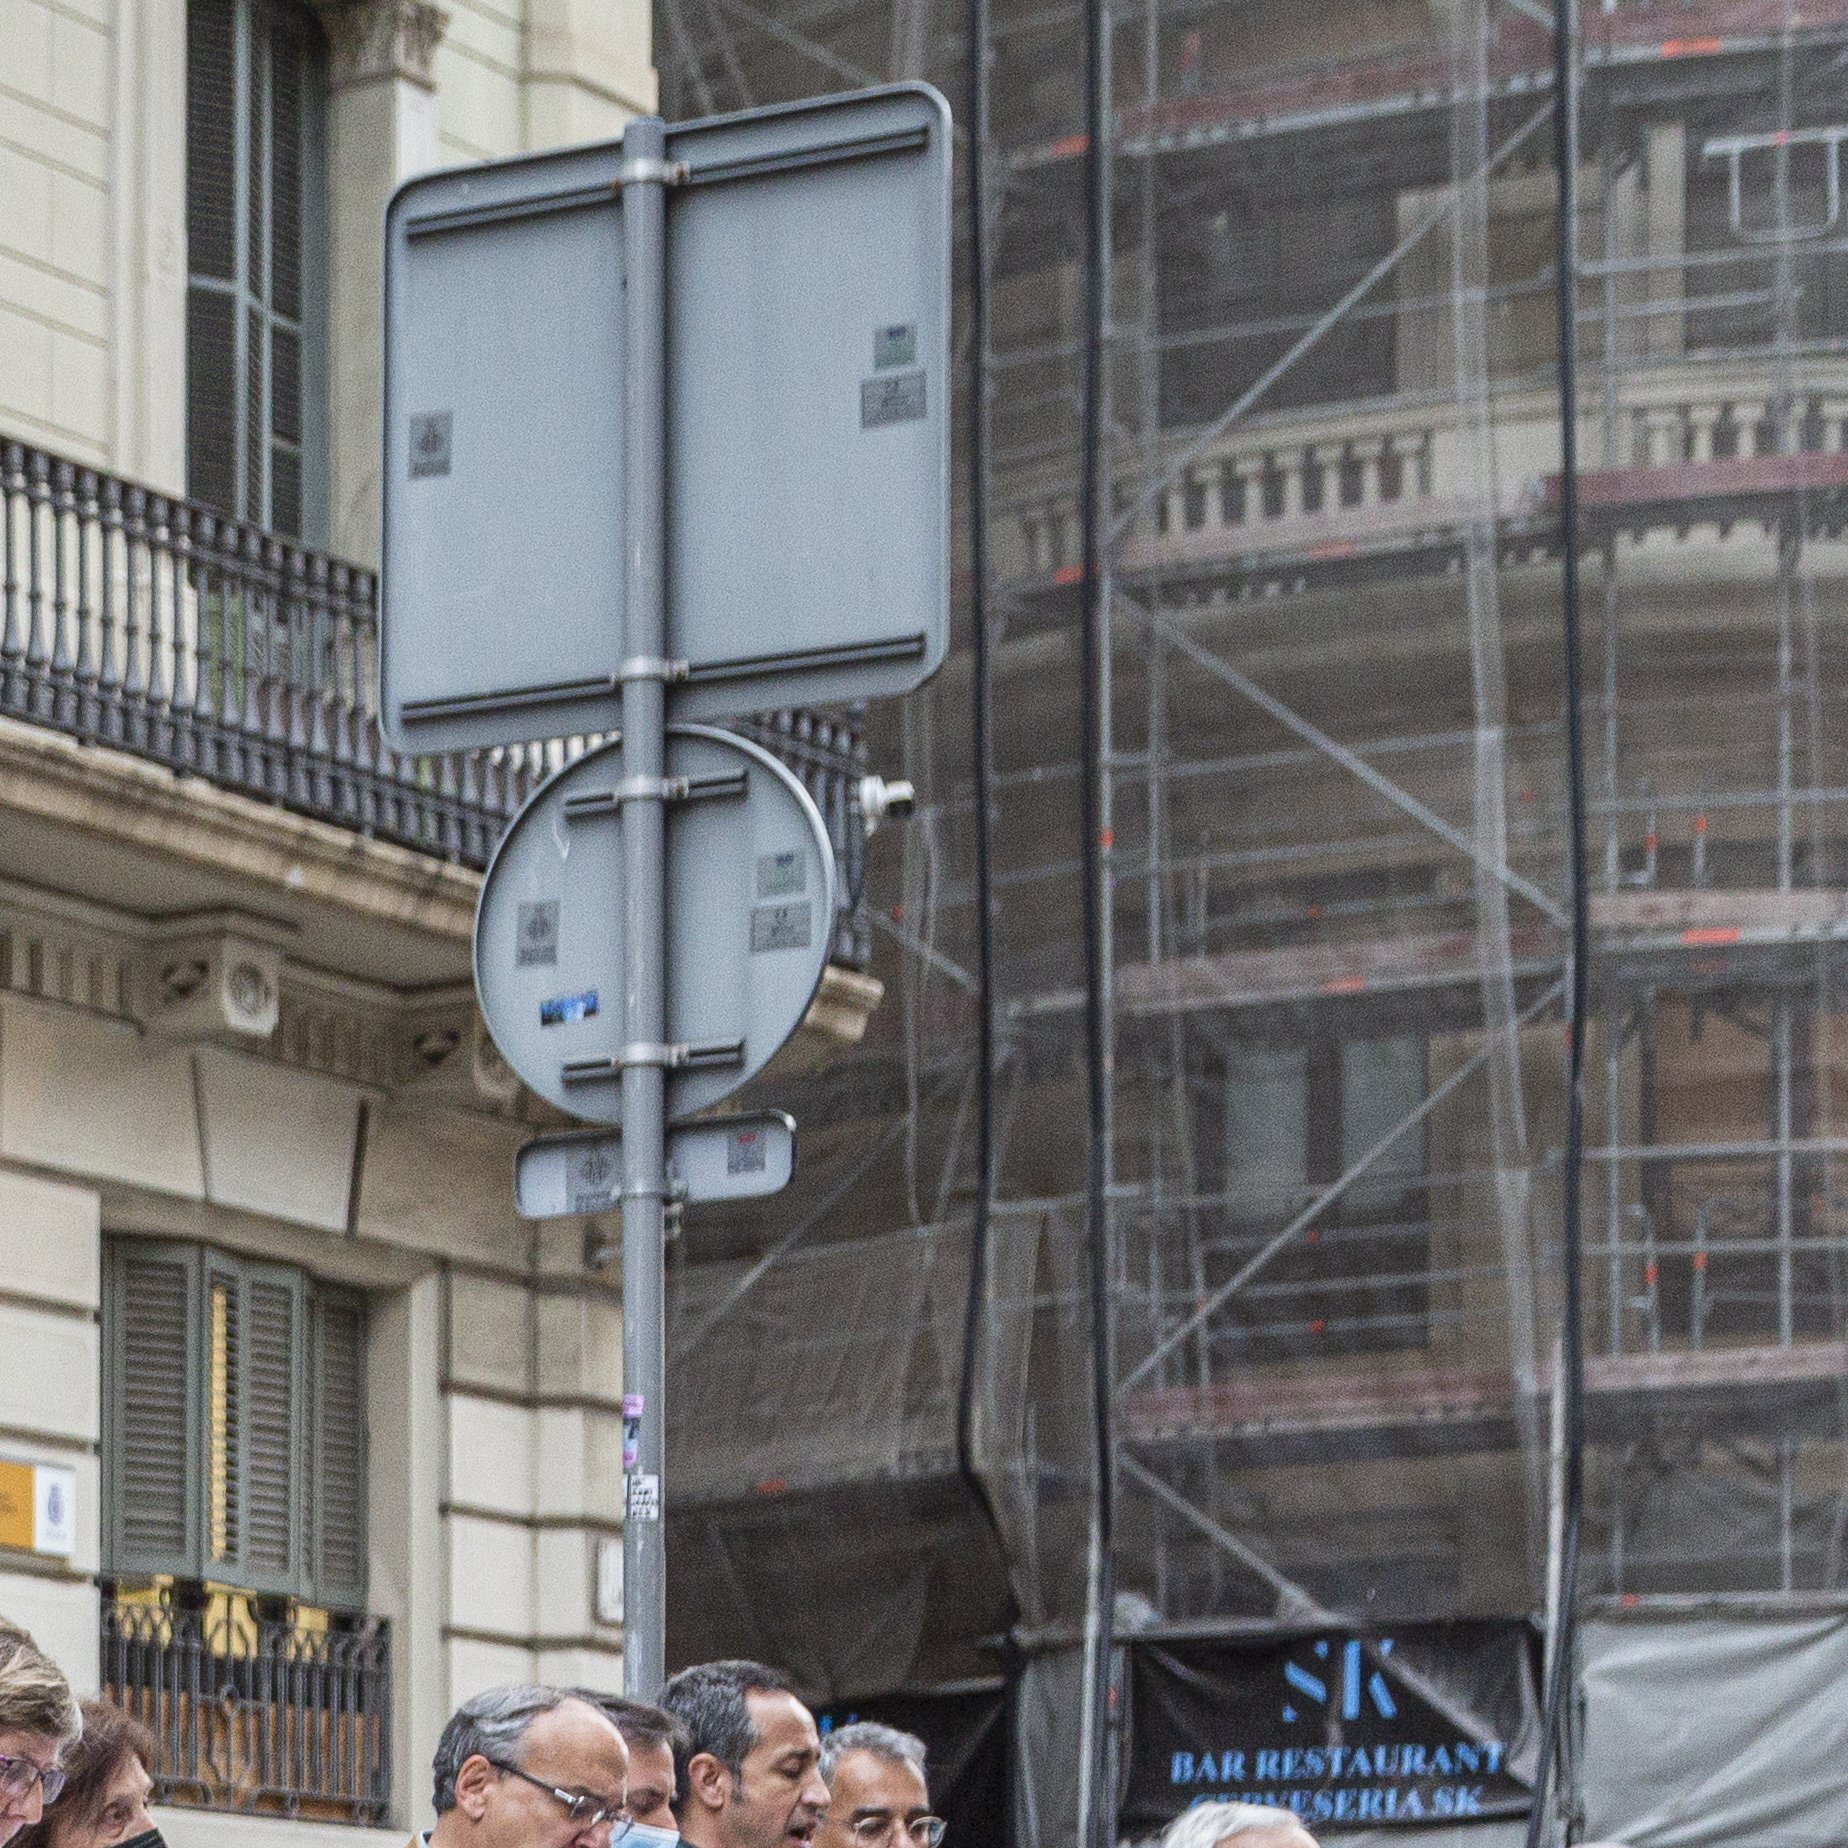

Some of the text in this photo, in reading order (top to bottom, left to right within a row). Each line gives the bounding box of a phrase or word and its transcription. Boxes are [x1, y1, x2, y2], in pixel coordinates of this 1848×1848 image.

[1170, 1740, 1506, 1785] BAR RESTAURANT
[1433, 1785, 1483, 1817] SK
